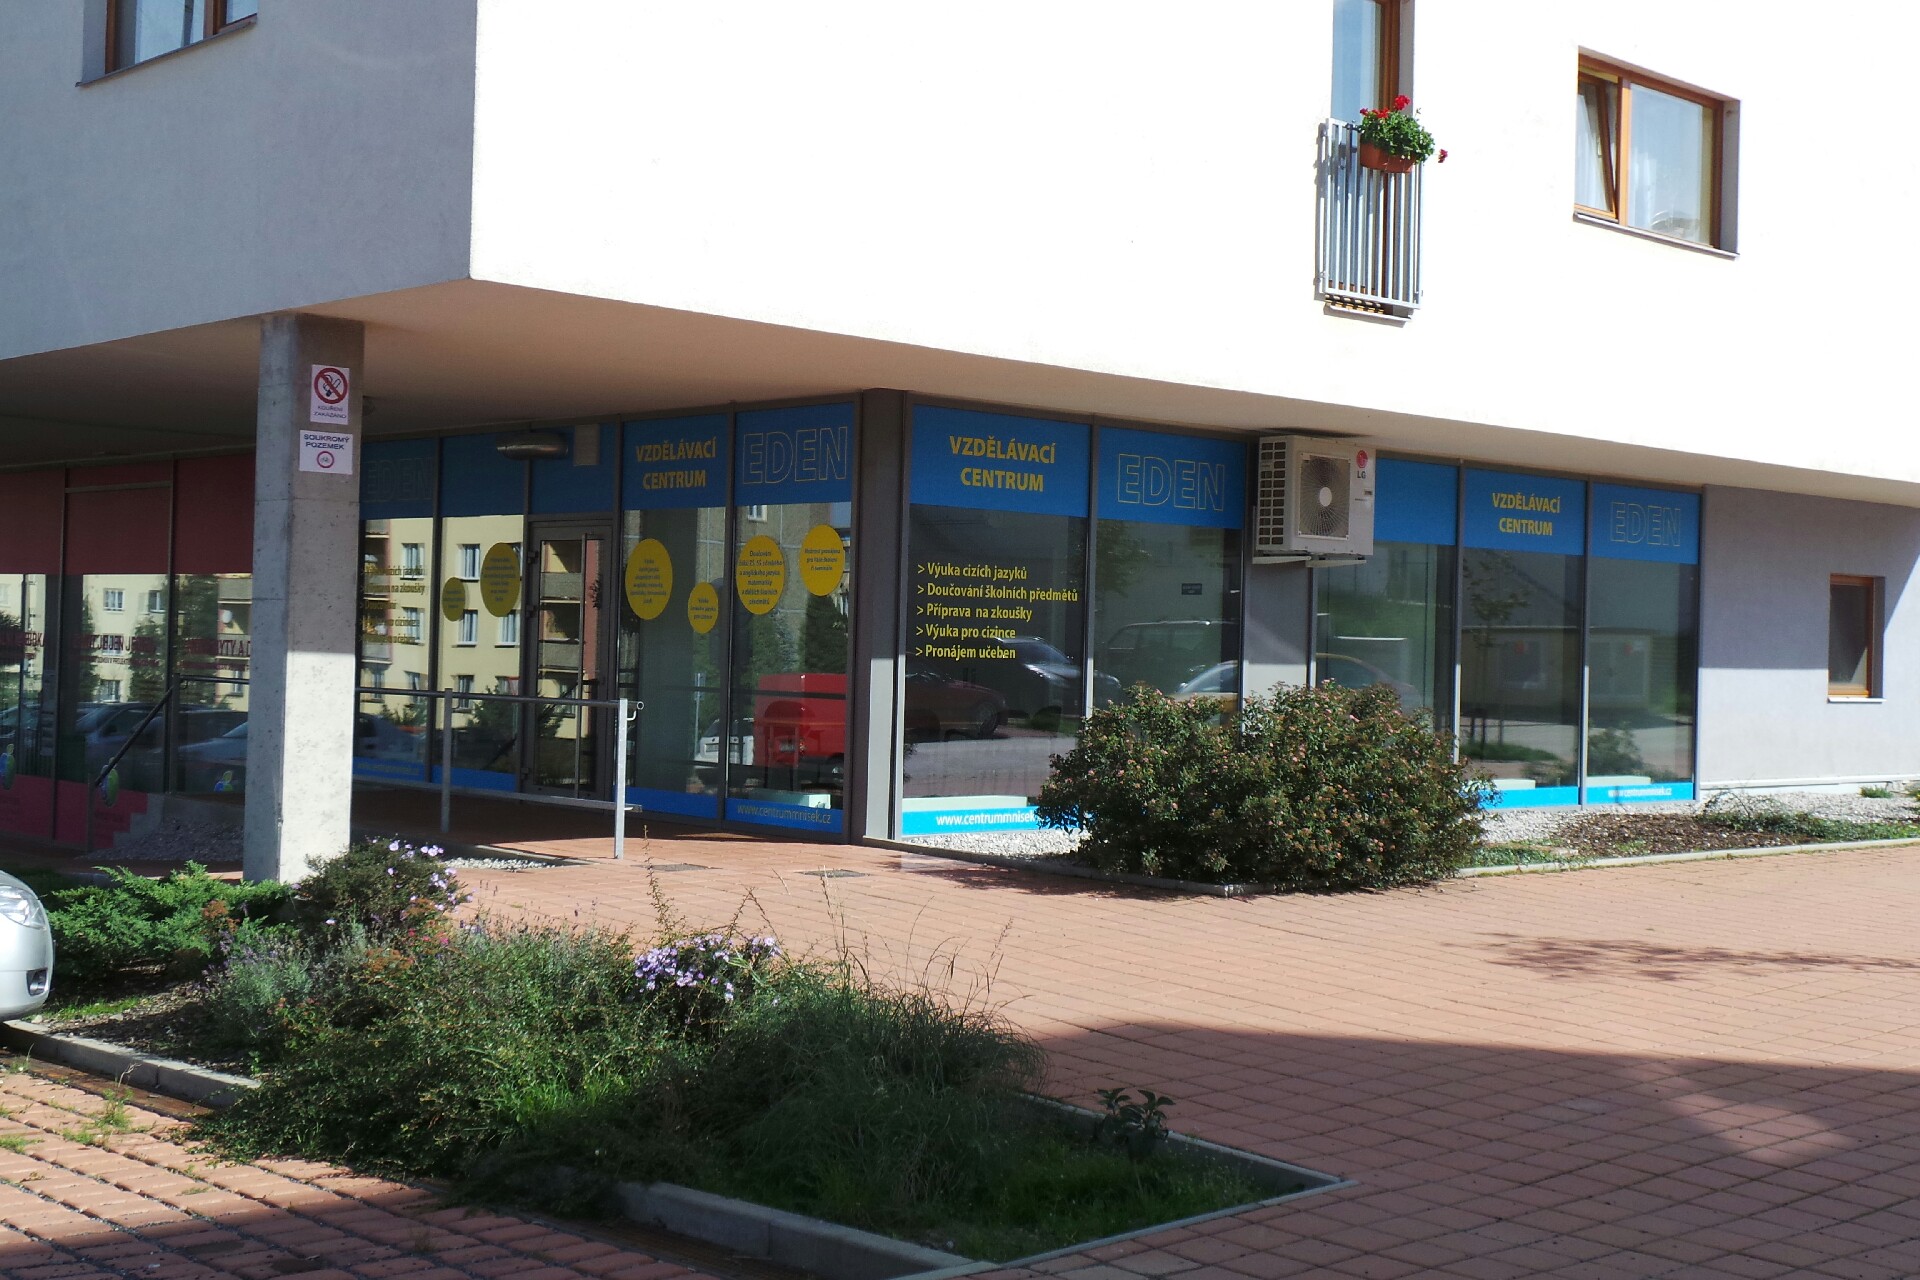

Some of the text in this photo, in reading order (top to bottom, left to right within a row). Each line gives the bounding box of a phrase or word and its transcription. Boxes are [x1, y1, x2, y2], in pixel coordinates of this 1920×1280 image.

[303, 434, 350, 443] SOUKROMÝ
[305, 442, 345, 450] POZEMEK
[636, 436, 717, 462] VZDĚLÁVACÍ
[743, 426, 848, 485] EDEN
[950, 435, 1056, 464] VZDĚLÁVACÍ
[642, 469, 706, 490] CENTRUM
[960, 467, 1044, 492] CENTRUM
[1118, 453, 1225, 511] EDEN
[1356, 471, 1367, 479] LG
[1492, 492, 1561, 514] VZDĚLÁVACÍ
[1498, 518, 1553, 536] CENTRUM
[1610, 501, 1681, 547] EDEN
[927, 562, 1027, 581] Výuka cizích jazyků
[927, 582, 1078, 603] Doučování školních předmětů
[926, 603, 1032, 622] Příprava na zkoušky
[925, 623, 1016, 640] Výuka pro cizince
[925, 644, 1016, 661] Pronájem učeben
[737, 804, 832, 824] www.centrummnisek.cz
[936, 810, 1036, 826] www.centrummnisek
